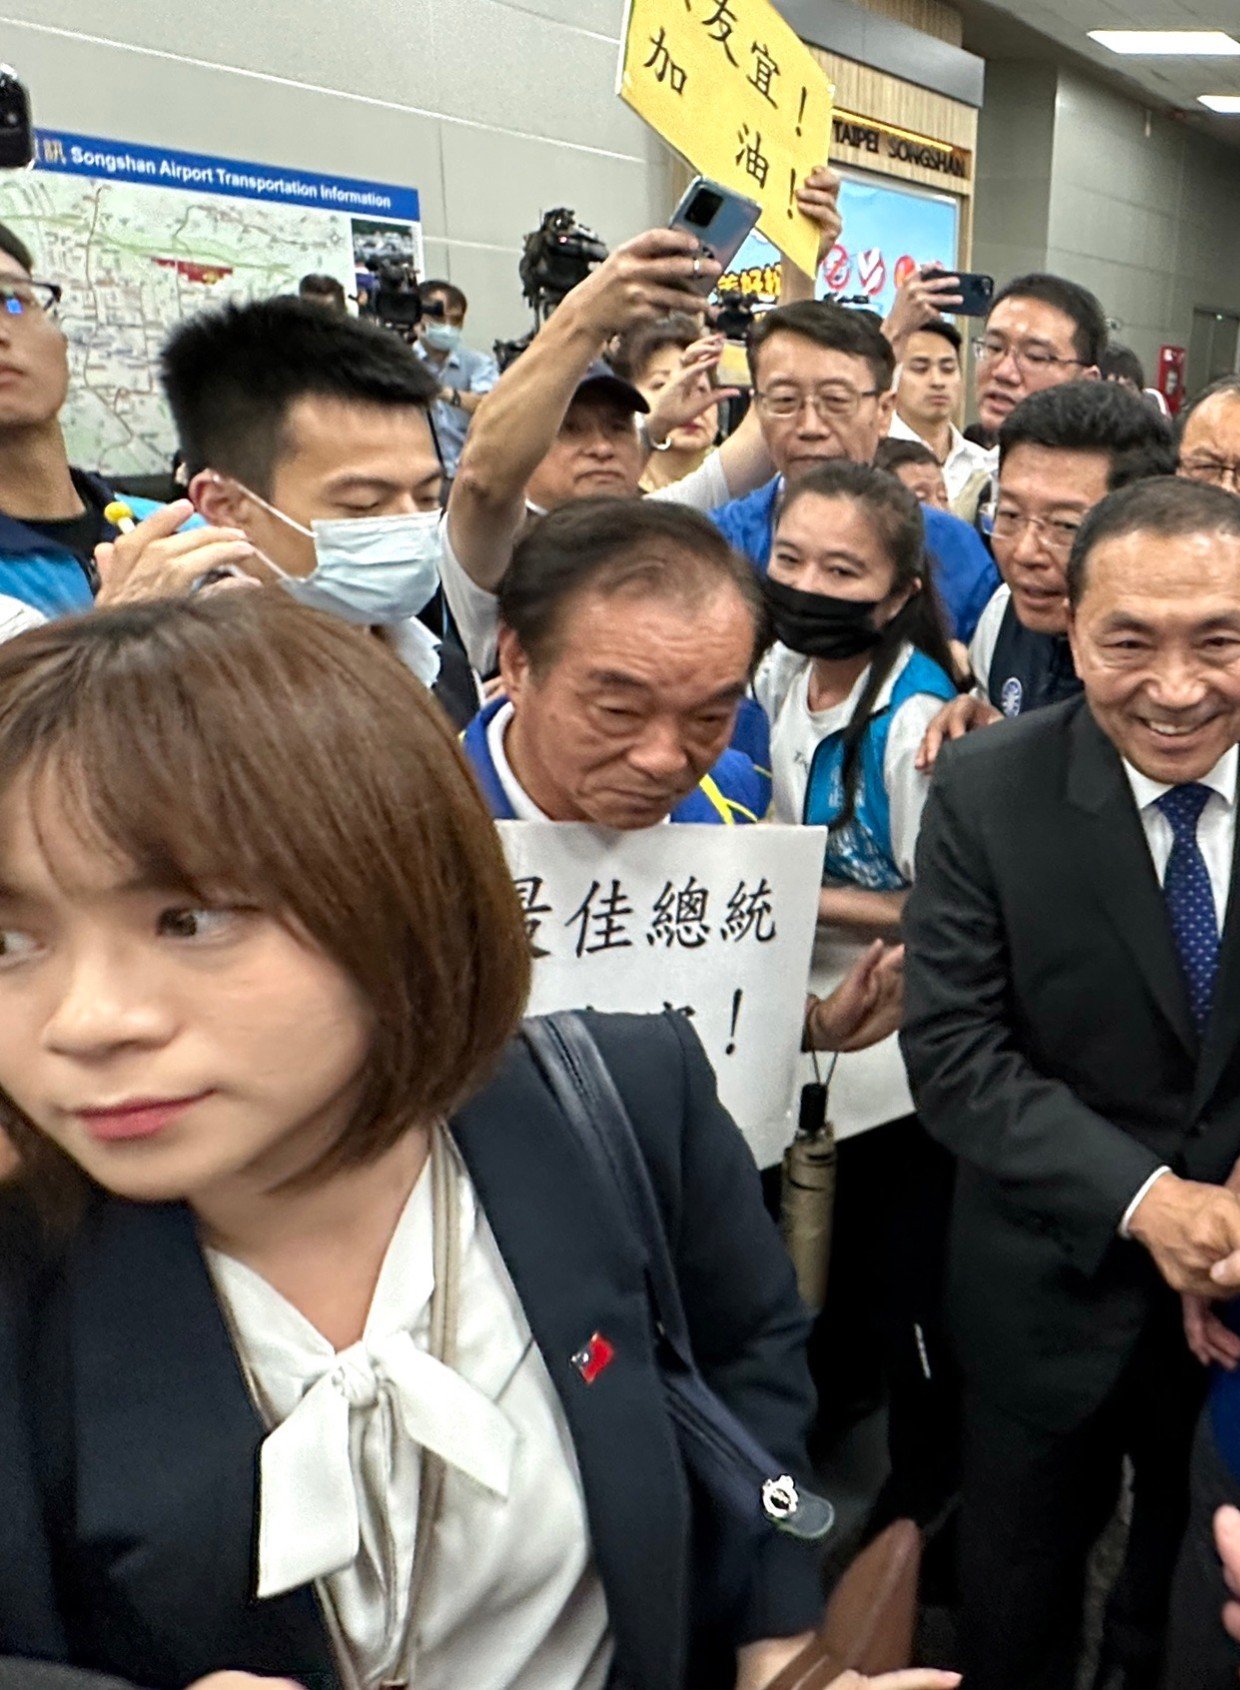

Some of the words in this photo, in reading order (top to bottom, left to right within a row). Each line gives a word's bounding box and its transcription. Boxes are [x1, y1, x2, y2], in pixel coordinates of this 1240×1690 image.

[683, 0, 807, 137] 友宜!
[71, 146, 156, 174] Songshan
[159, 160, 213, 184] Airport
[216, 168, 318, 198] Transportation
[320, 184, 392, 209] Information
[832, 119, 880, 154] TAIPEI
[886, 136, 966, 178] SONGSHAN
